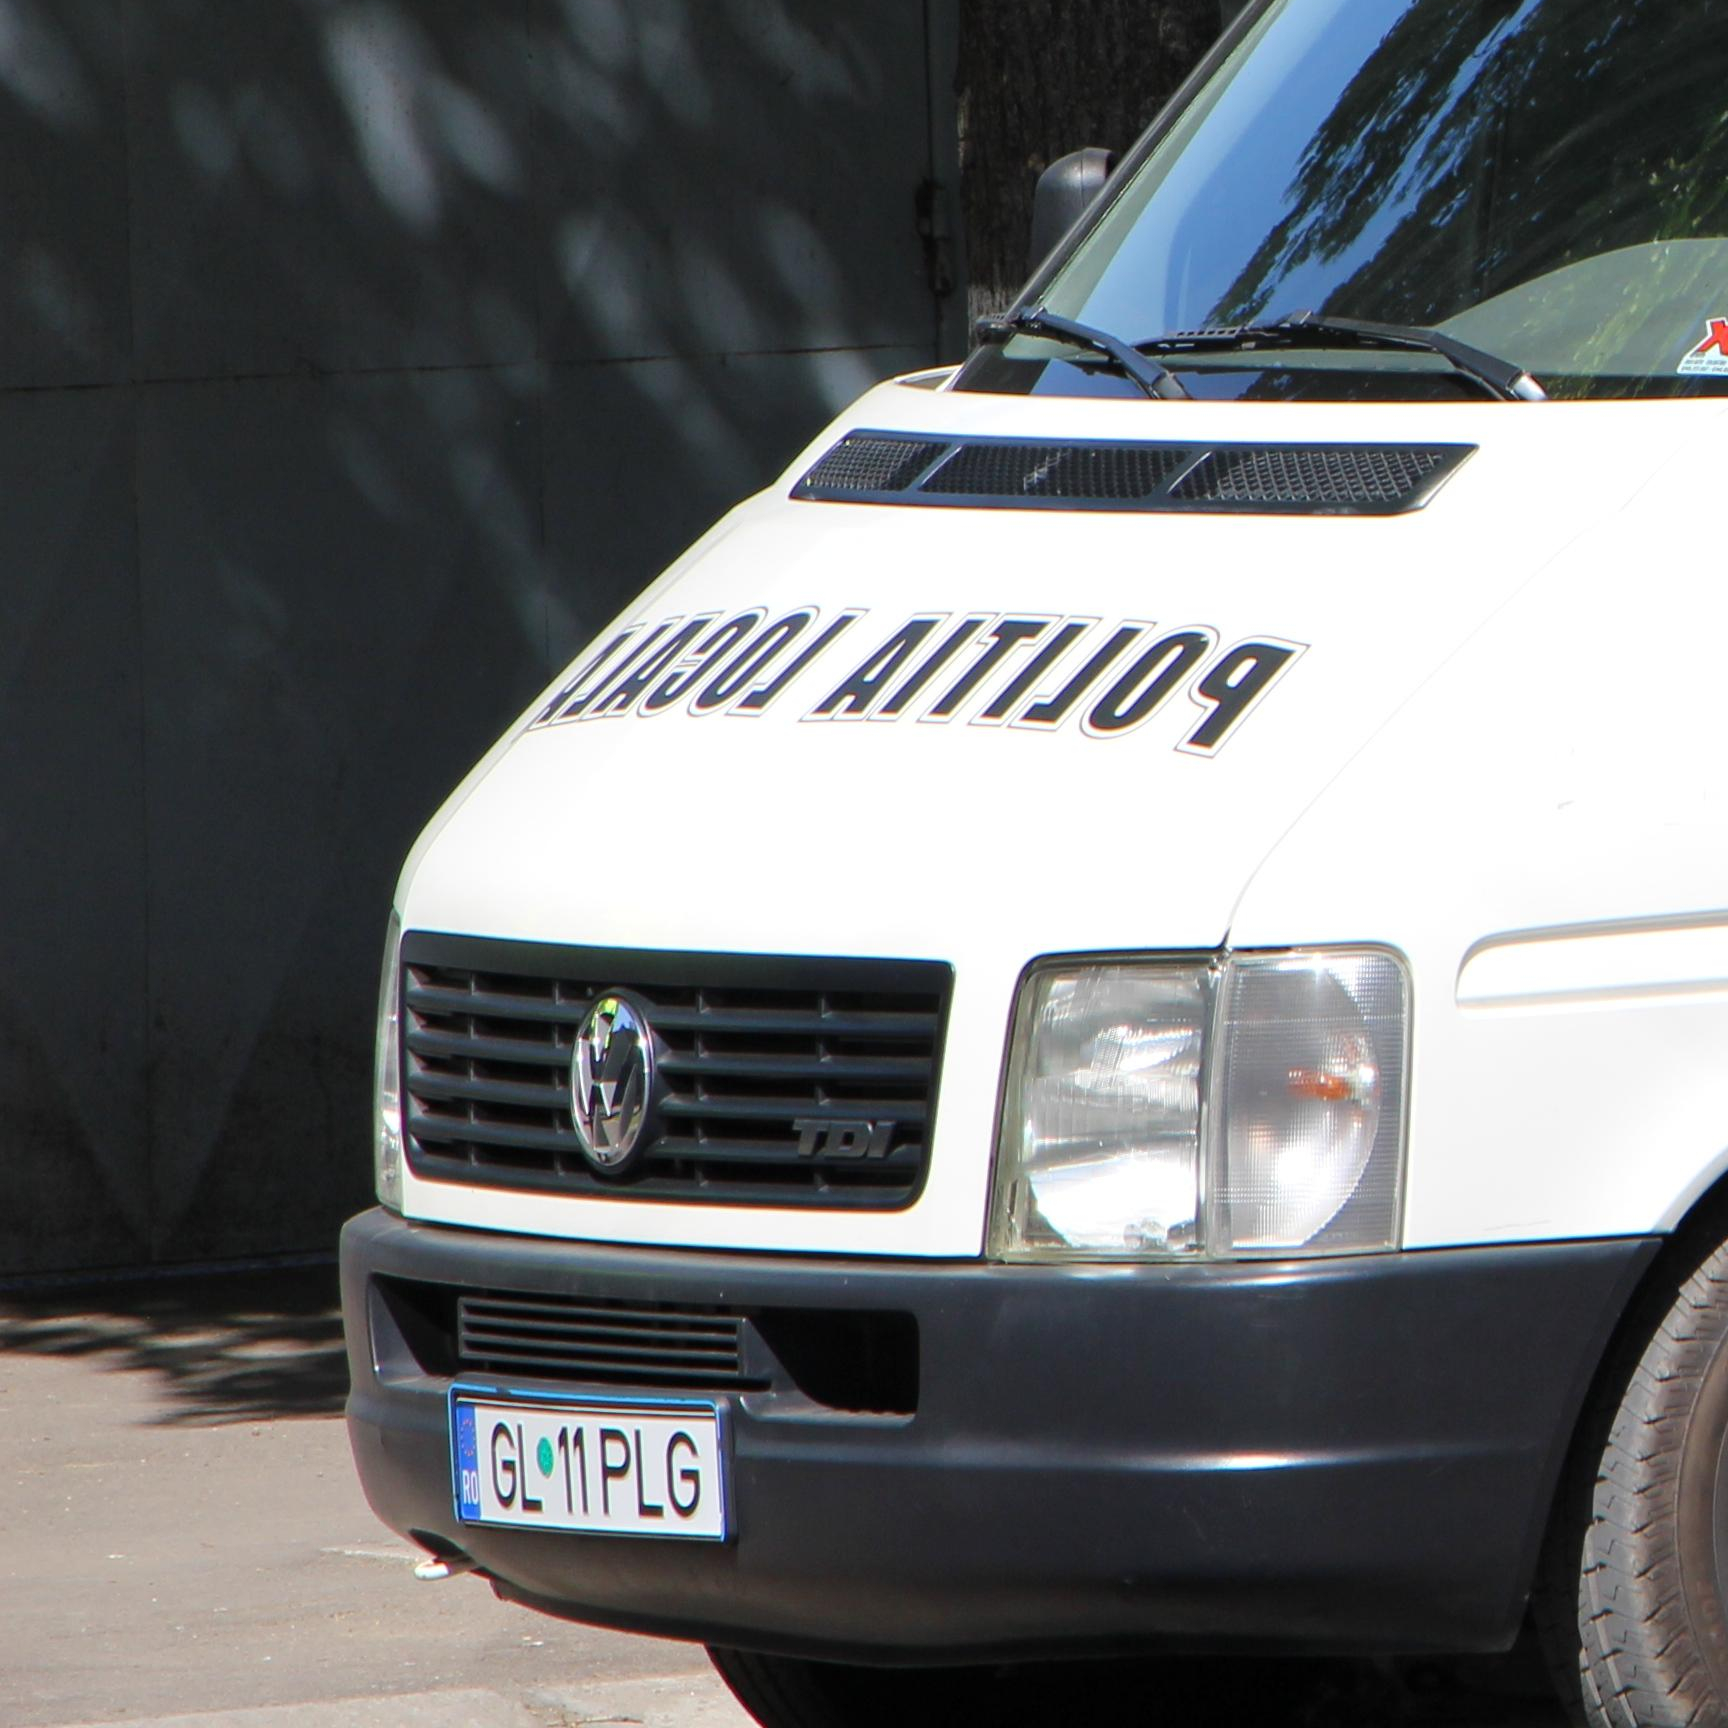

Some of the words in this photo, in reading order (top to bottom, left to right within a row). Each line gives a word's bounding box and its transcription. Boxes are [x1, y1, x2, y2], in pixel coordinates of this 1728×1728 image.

[792, 1118, 897, 1159] TDI
[461, 1469, 480, 1505] RO
[490, 1421, 543, 1512] GL
[558, 1426, 590, 1516] 11
[600, 1427, 701, 1519] PLG
